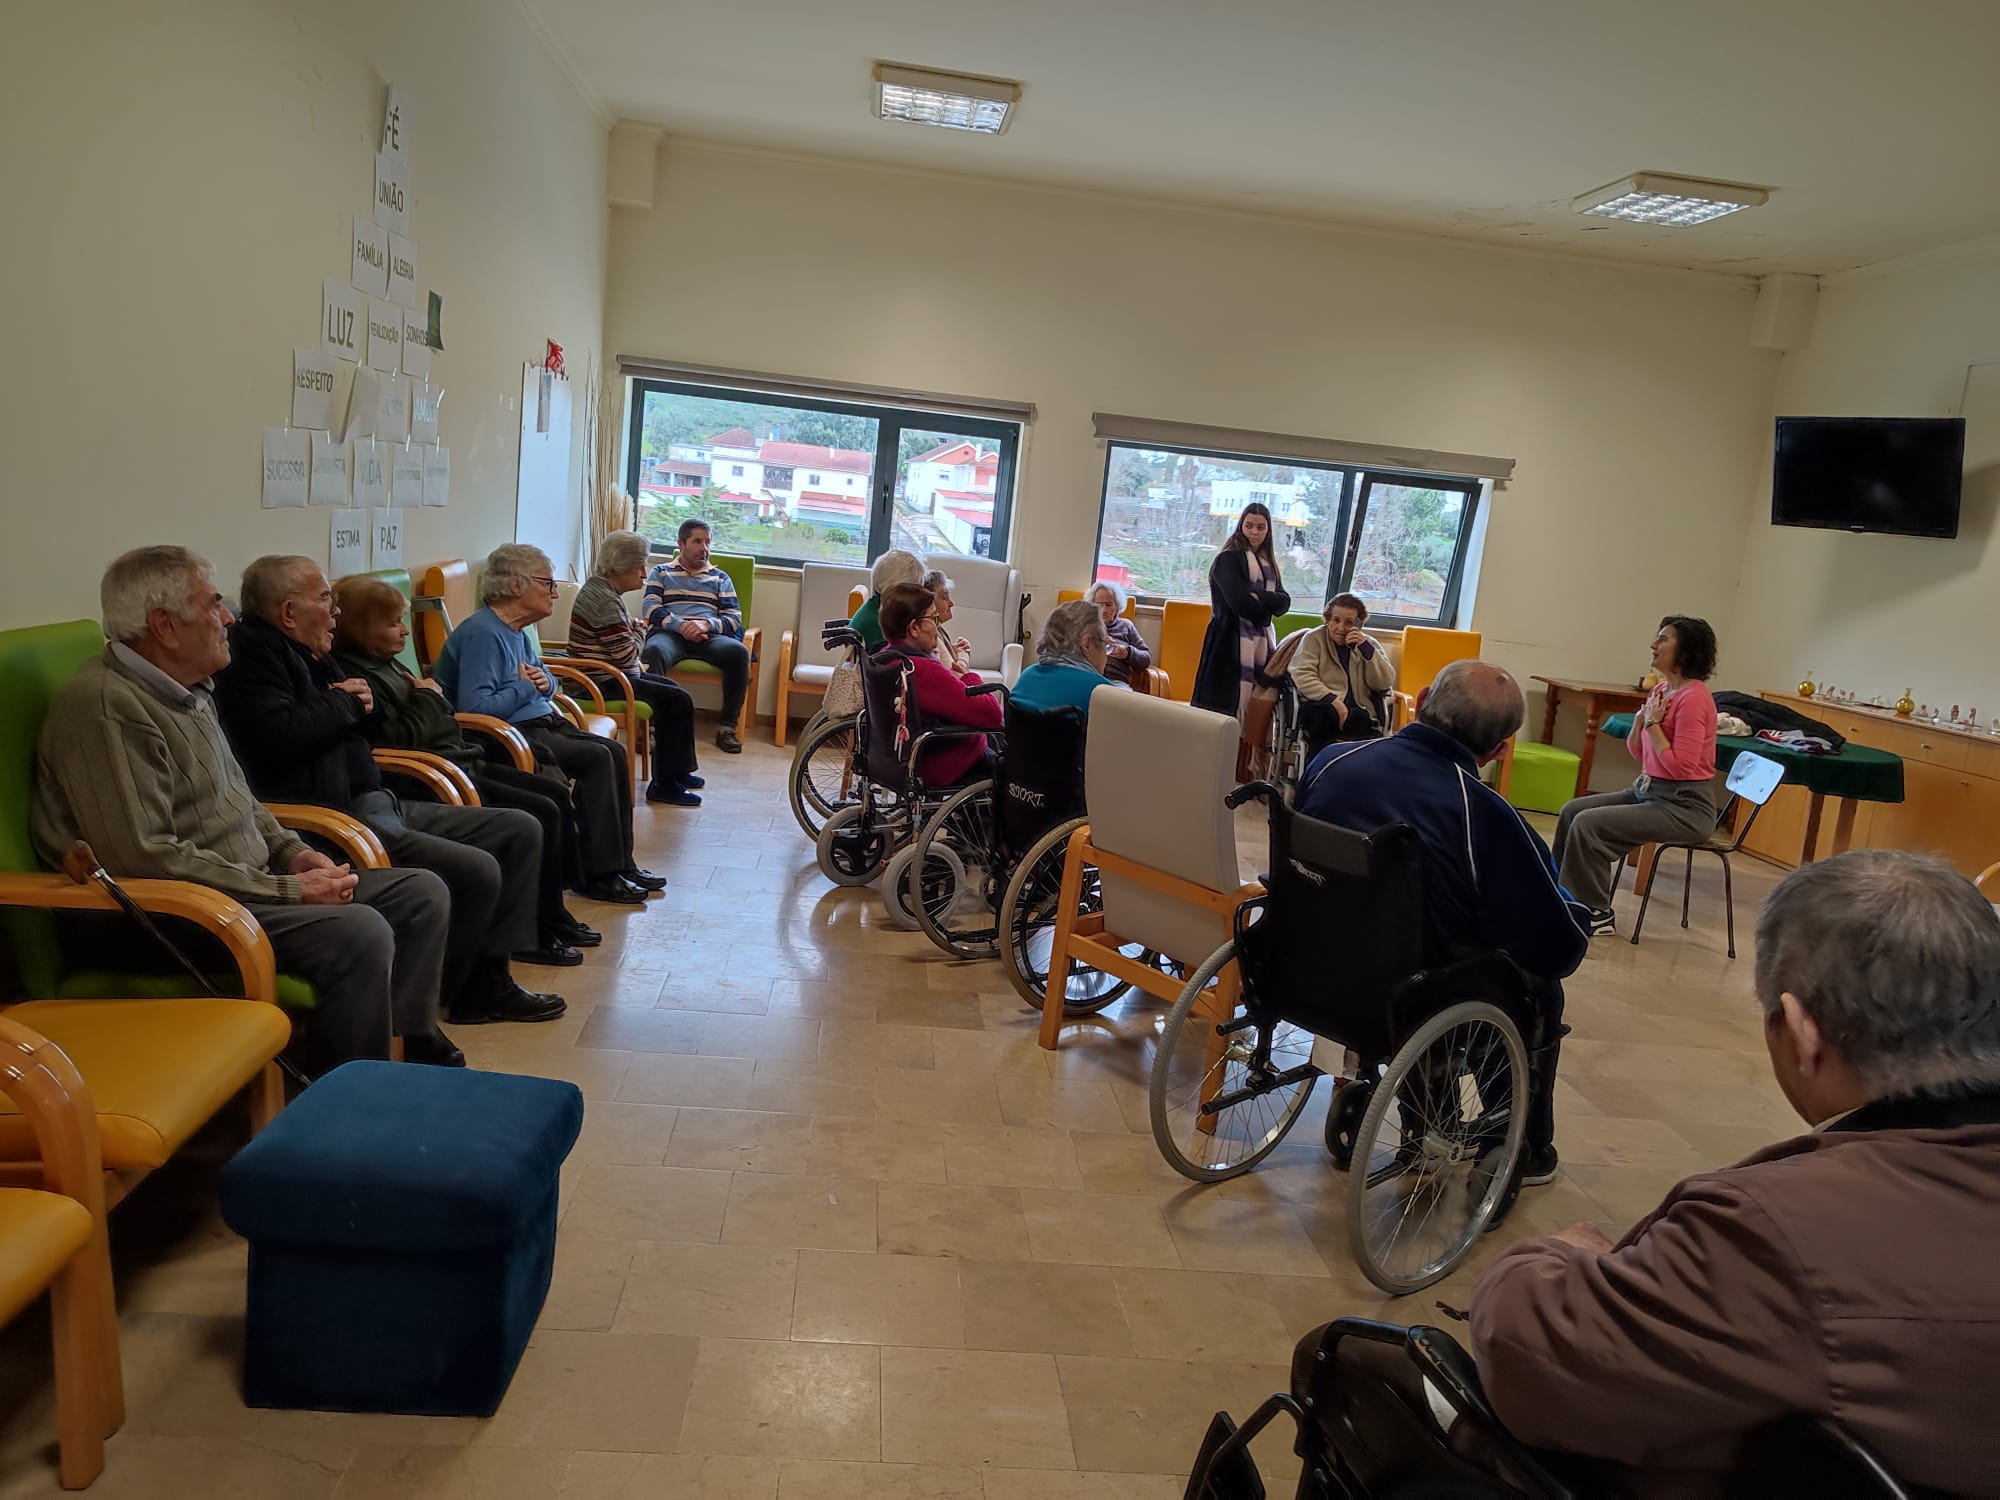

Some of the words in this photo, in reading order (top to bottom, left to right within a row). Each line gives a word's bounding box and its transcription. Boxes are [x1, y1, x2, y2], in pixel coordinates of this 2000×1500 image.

[378, 178, 404, 213] UNIÃO
[357, 239, 384, 271] FAMÍLIA
[392, 255, 415, 281] ALEGRIA
[328, 303, 355, 349] LUZ
[370, 321, 399, 344] REALIZAÇÃO
[406, 324, 429, 347] SONHOS
[296, 368, 334, 393] RESPEITO
[266, 458, 305, 481] SUCESSO
[359, 458, 382, 486] VDA
[336, 529, 360, 549] ESTIMA
[380, 525, 398, 552] PAZ
